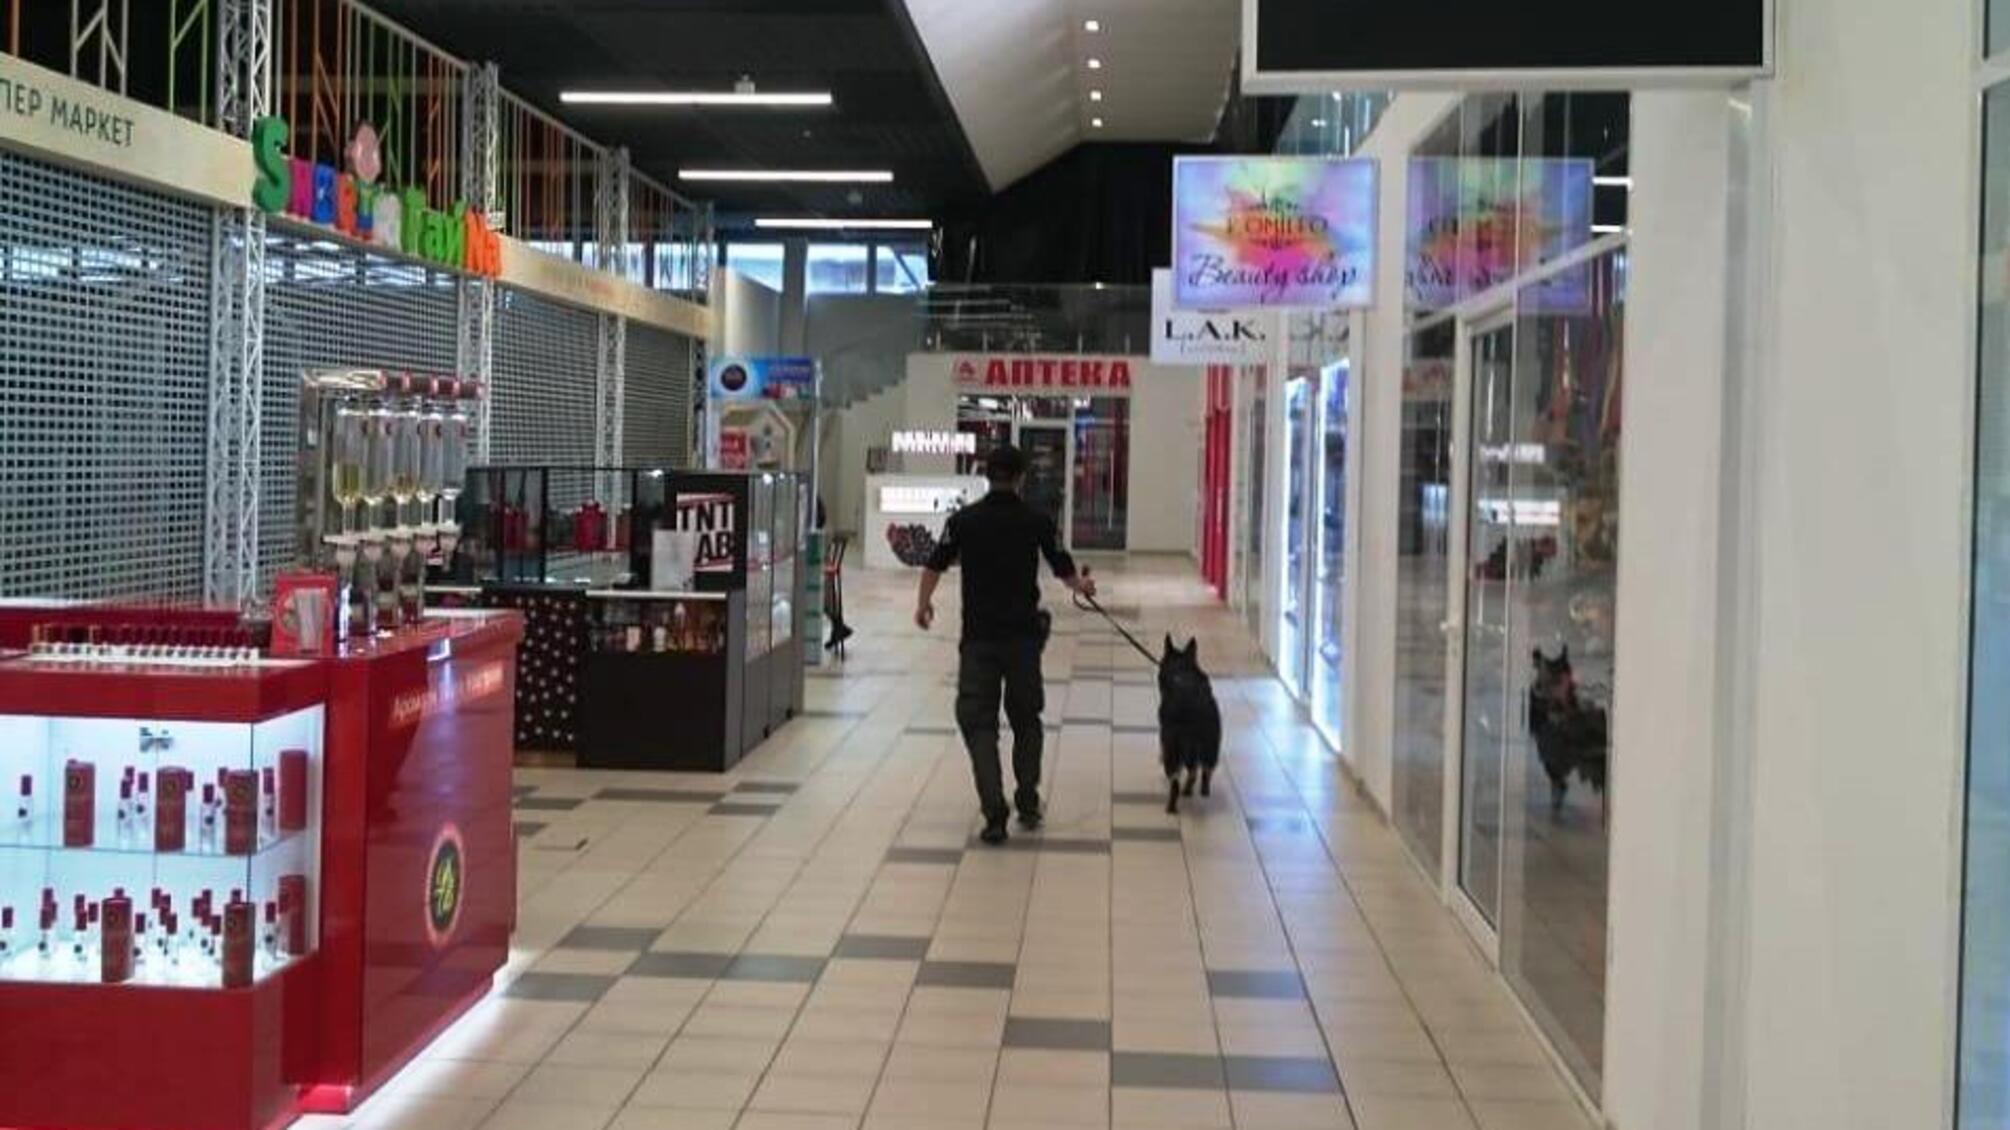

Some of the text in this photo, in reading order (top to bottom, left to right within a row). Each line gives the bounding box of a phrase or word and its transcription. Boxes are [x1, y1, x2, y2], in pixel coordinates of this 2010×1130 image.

[50, 95, 136, 147] МАРКЕТ
[1188, 253, 1289, 305] Beauty
[1296, 250, 1357, 300] shop
[984, 358, 1132, 388] АПТЕКА
[676, 501, 733, 533] TNT
[694, 530, 734, 566] AB
